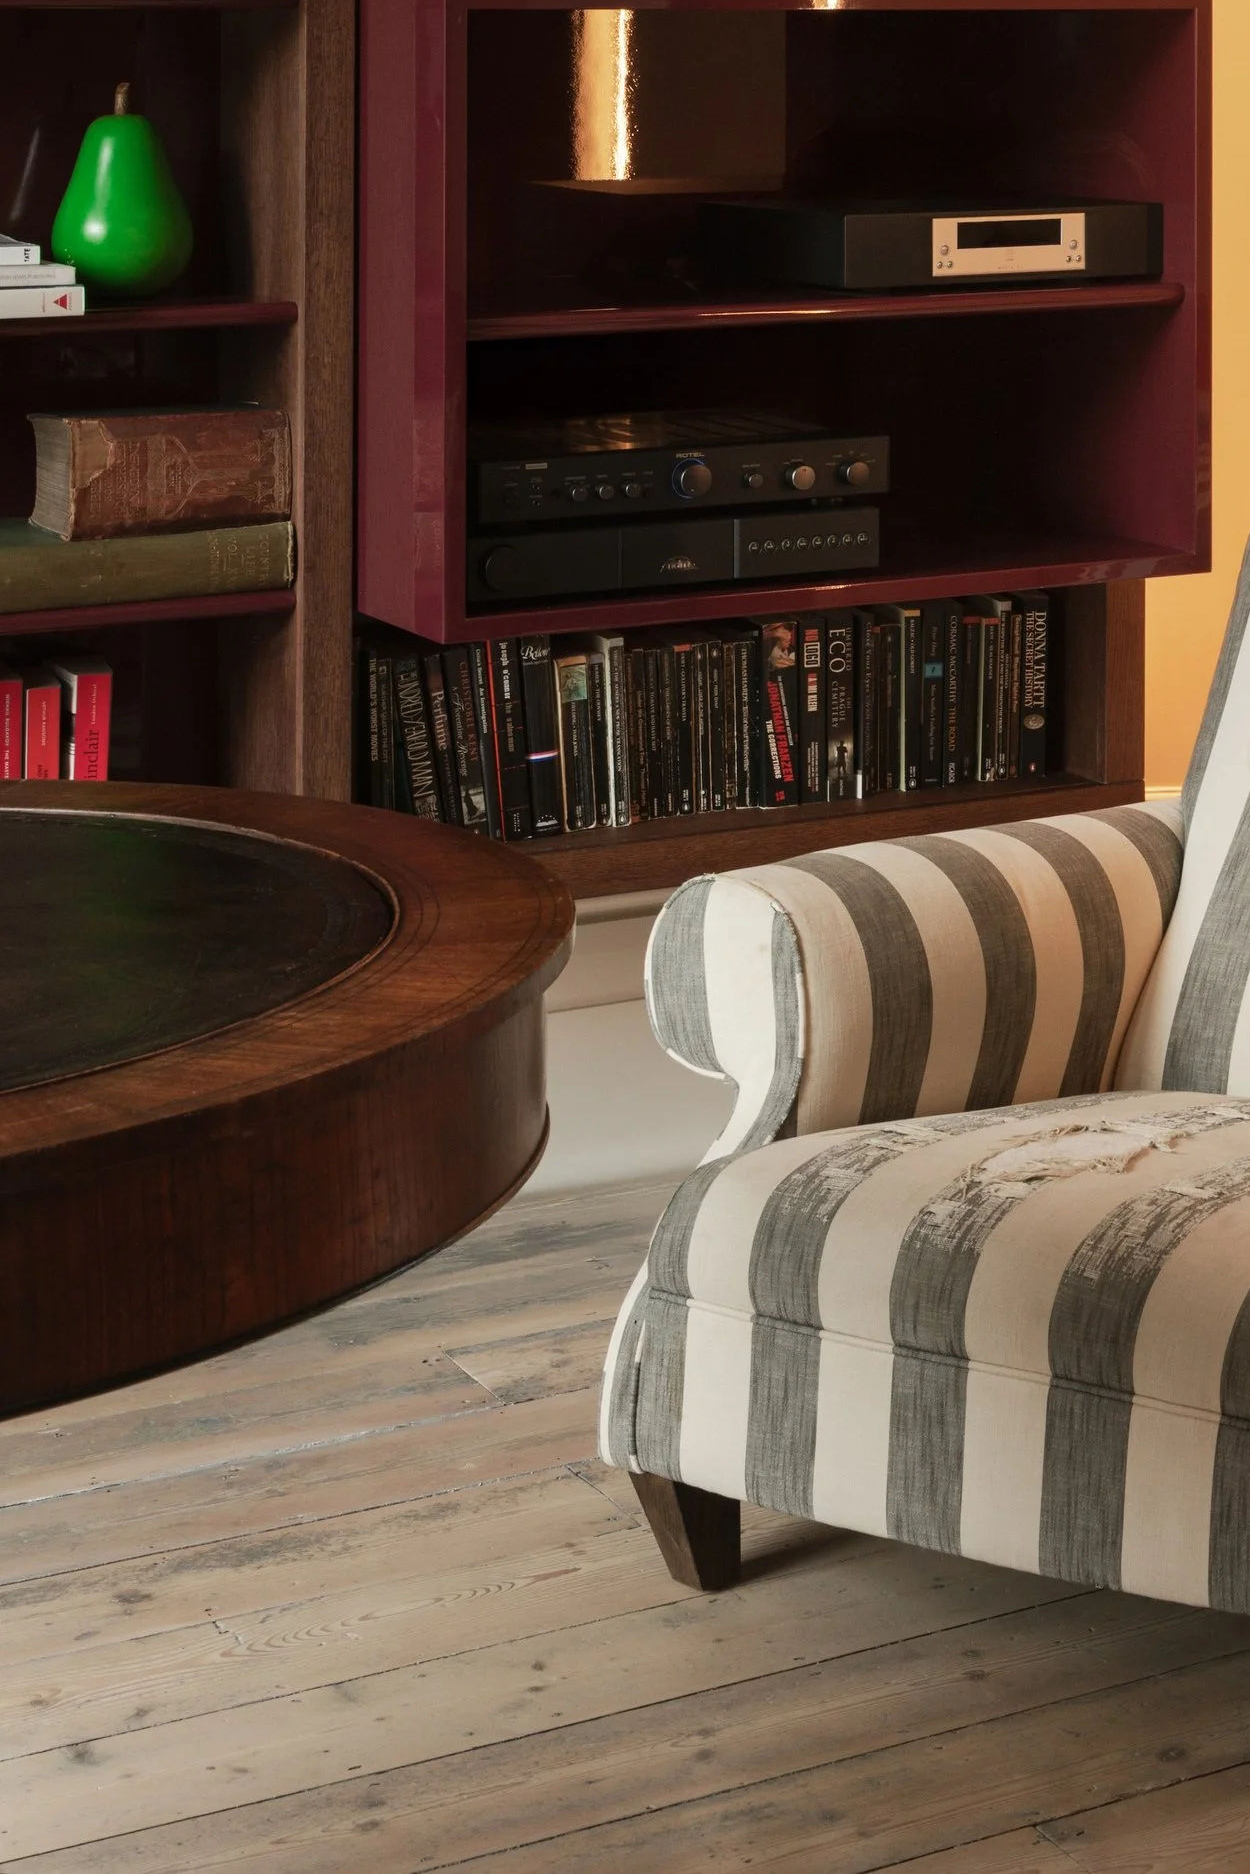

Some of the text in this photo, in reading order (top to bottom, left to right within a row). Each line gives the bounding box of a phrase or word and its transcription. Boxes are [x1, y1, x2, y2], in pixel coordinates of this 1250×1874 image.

[804, 642, 820, 668] LOGO
[828, 629, 846, 673] ECO
[1033, 611, 1048, 709] DONNA TARTT
[767, 681, 786, 733] JONATHAN
